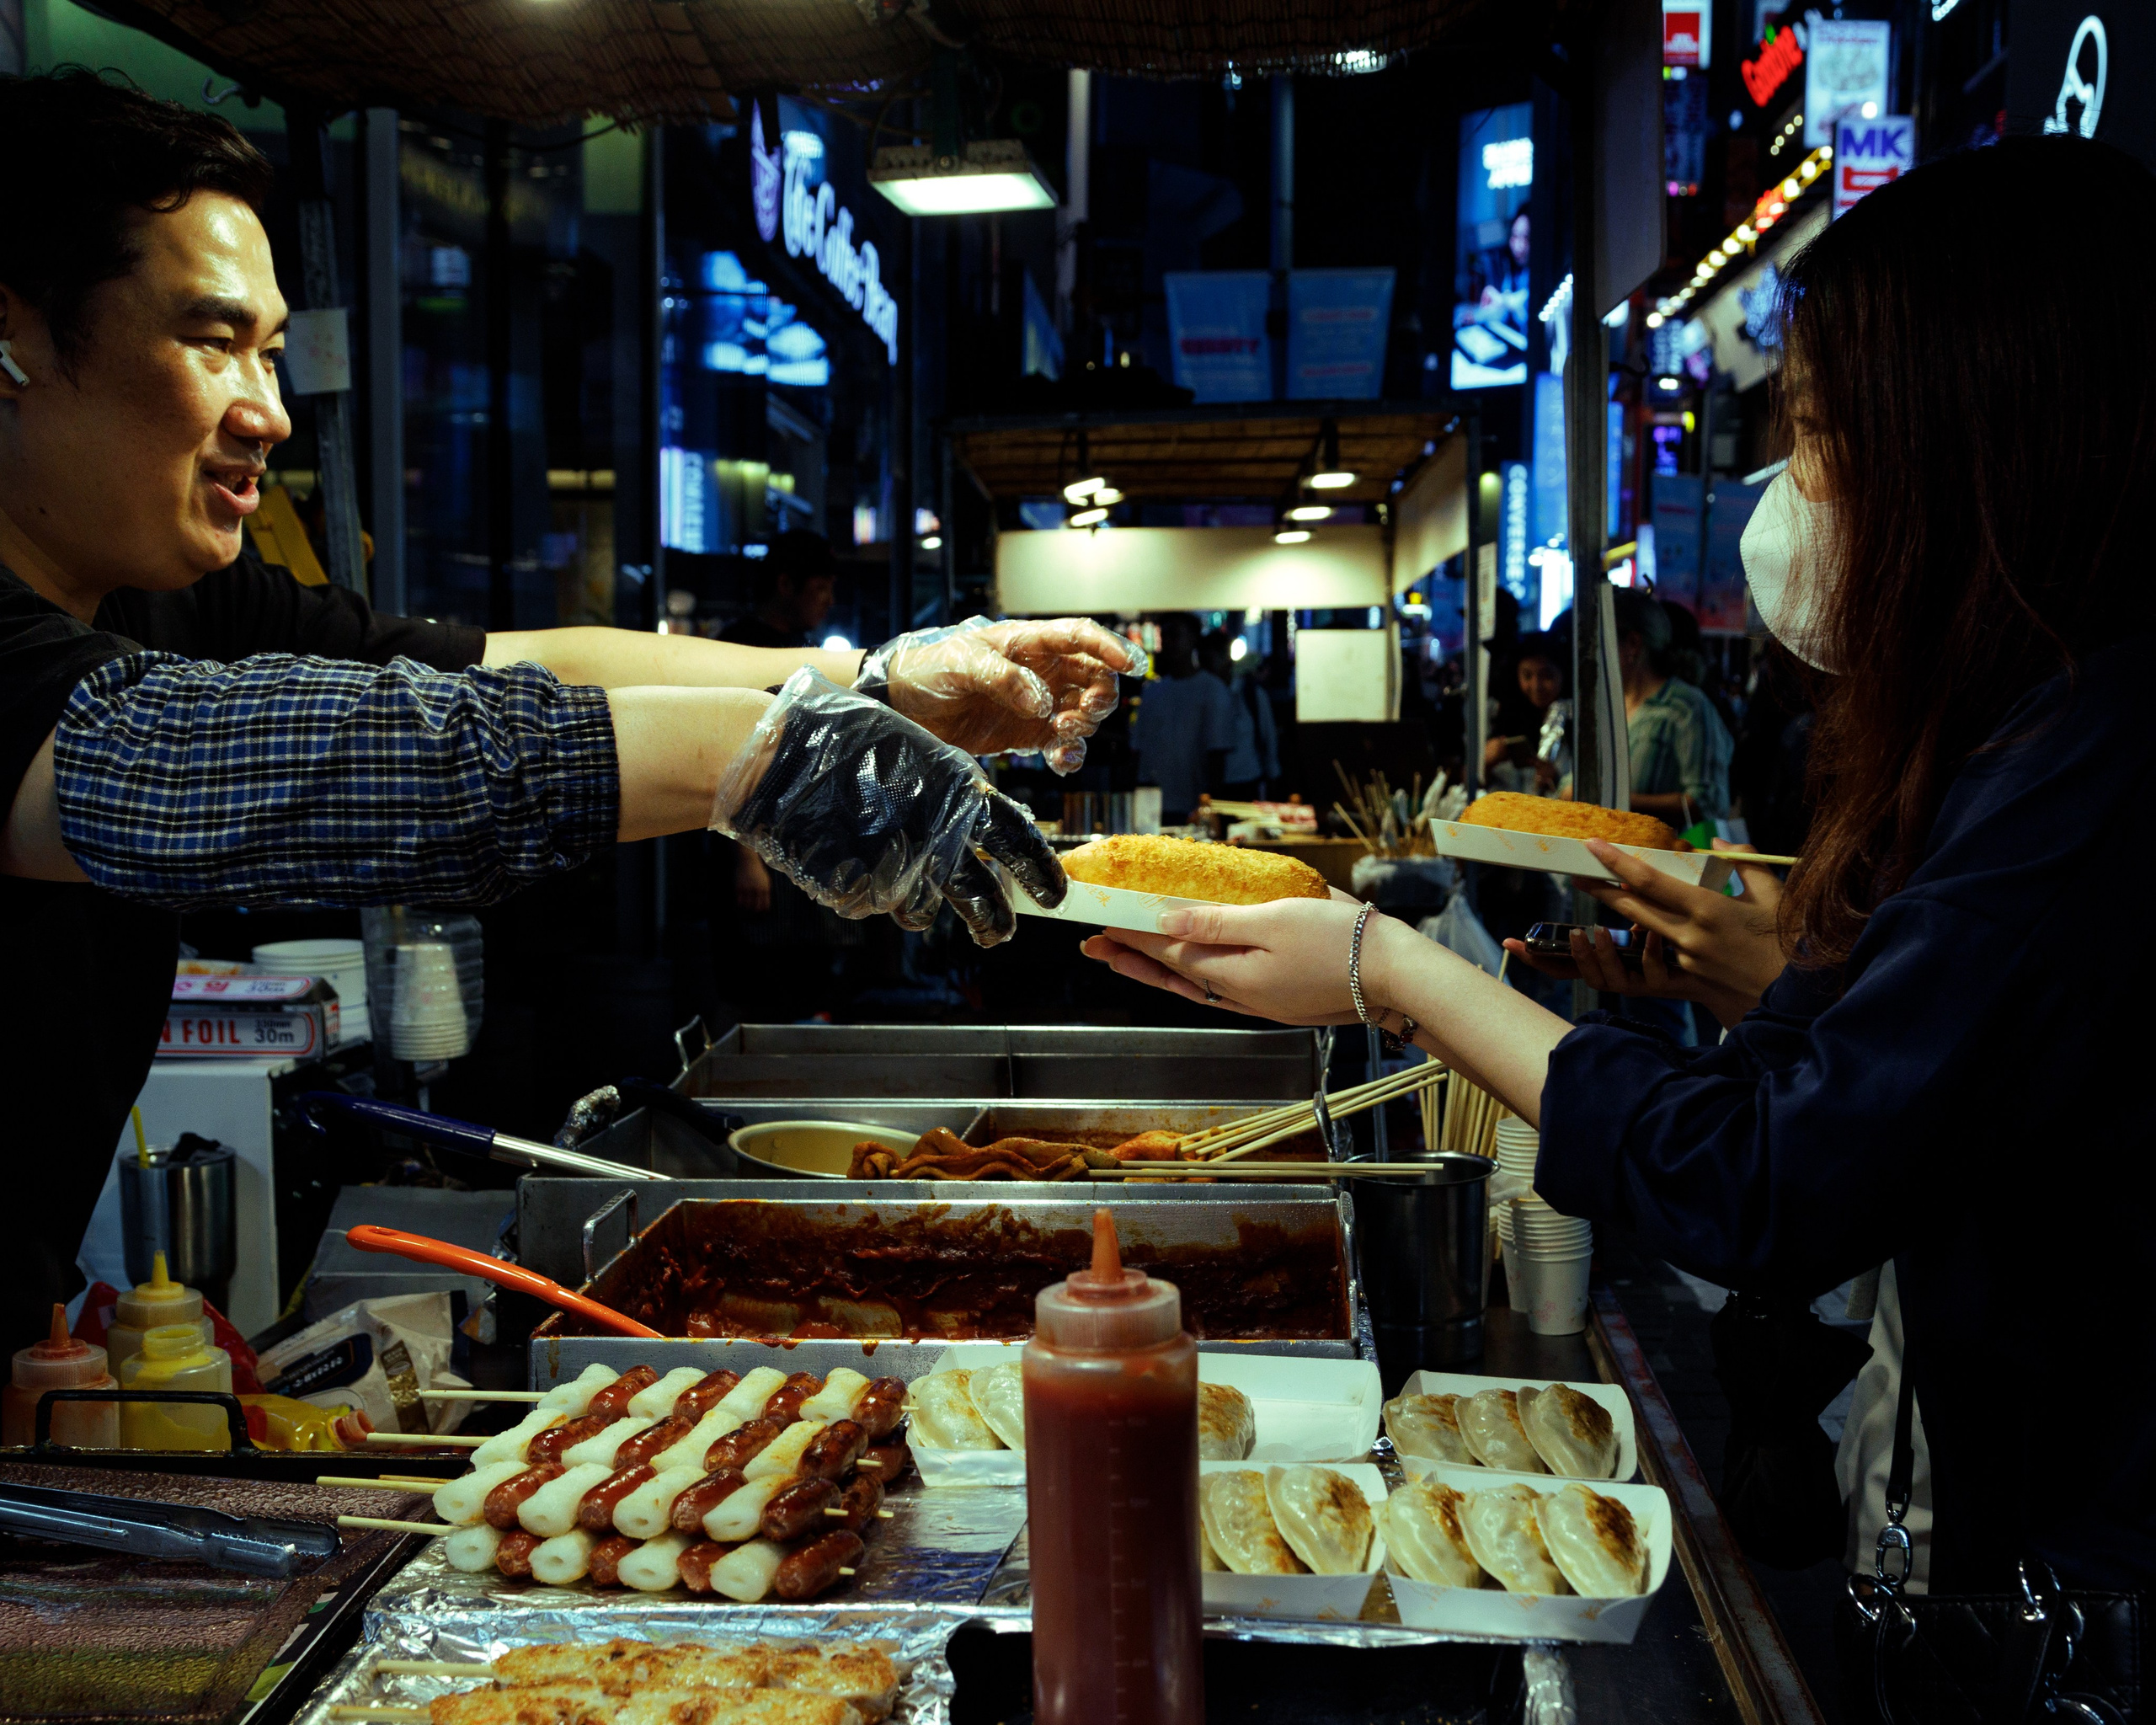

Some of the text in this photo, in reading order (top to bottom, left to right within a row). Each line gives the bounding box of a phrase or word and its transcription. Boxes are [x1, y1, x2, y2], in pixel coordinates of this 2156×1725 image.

[1842, 128, 1905, 157] MK
[1506, 464, 1528, 582] CONVERSE
[183, 1019, 242, 1044] FOIL
[254, 1028, 295, 1044] 30m
